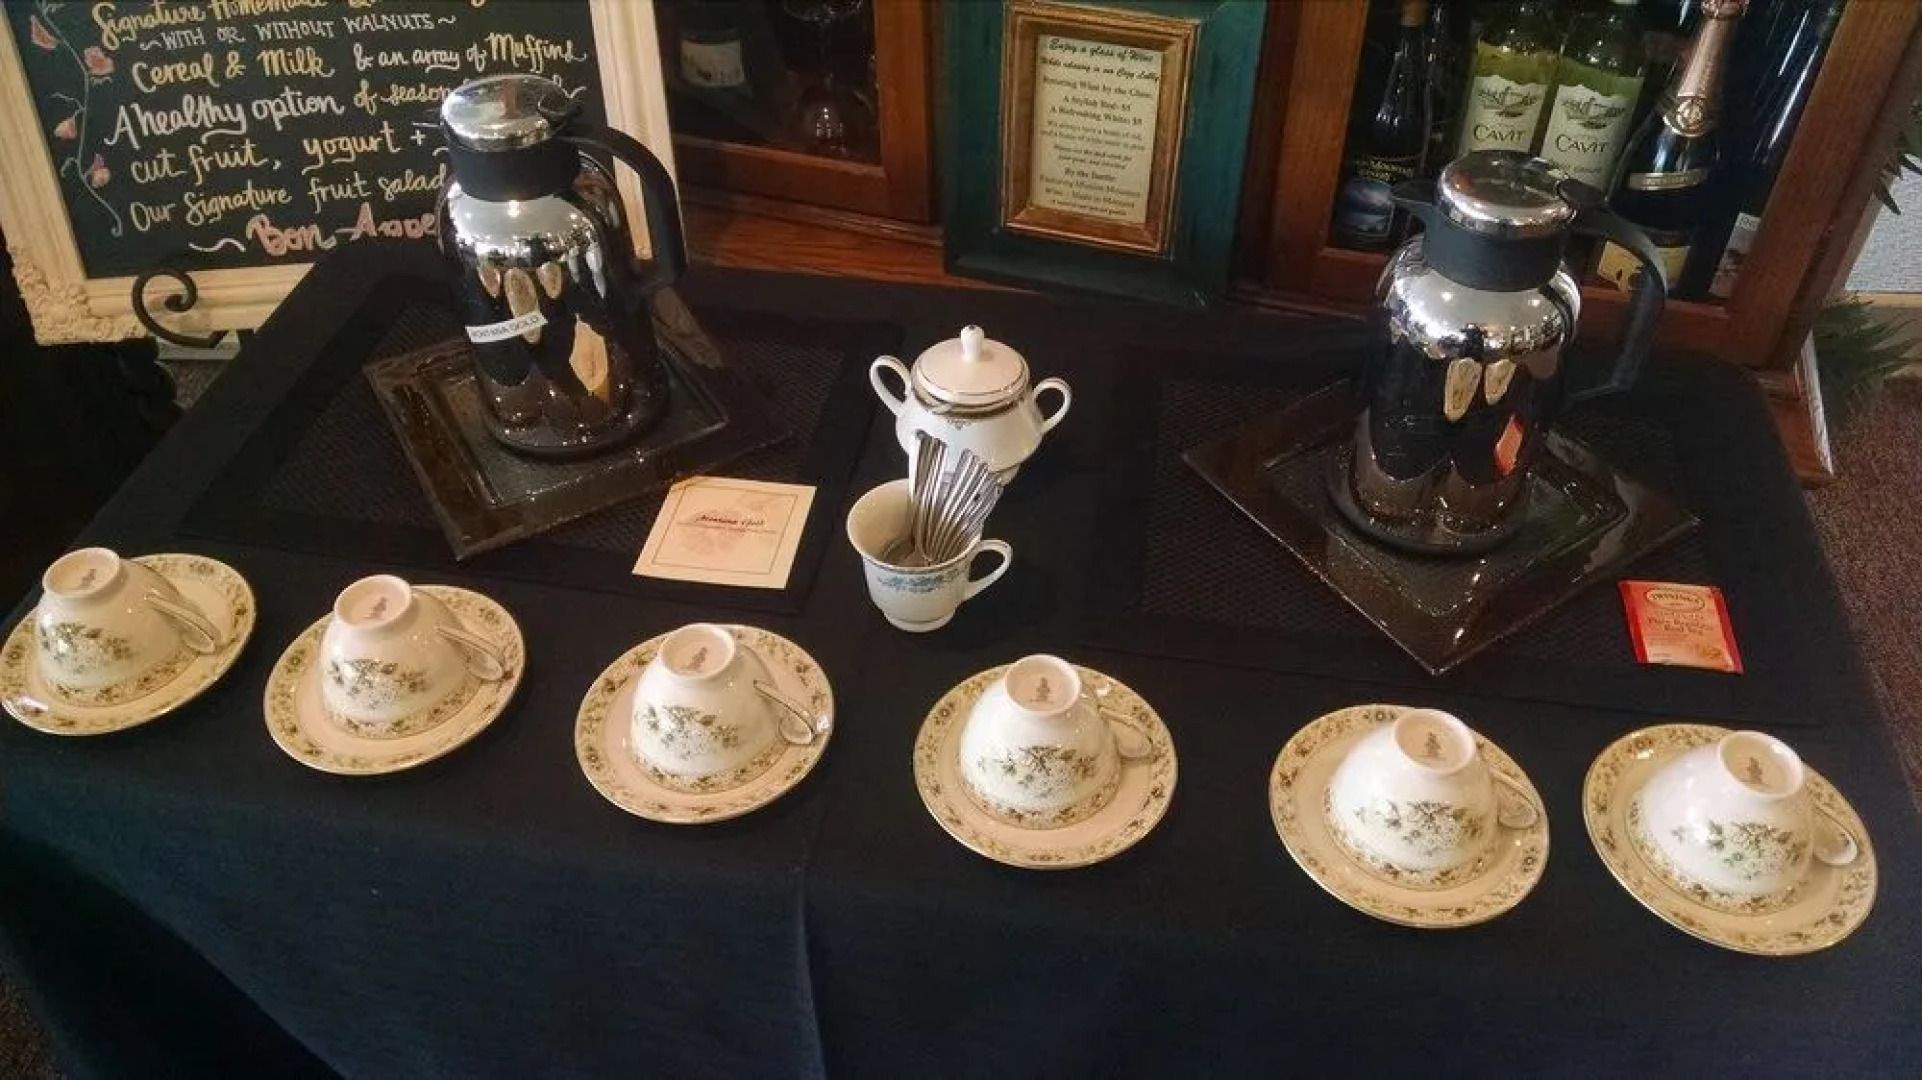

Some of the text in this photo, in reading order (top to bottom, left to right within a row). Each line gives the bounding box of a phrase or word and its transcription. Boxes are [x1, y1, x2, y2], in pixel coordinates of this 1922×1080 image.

[92, 2, 205, 49] Signature
[161, 14, 435, 49] WITH OR WITHOUT WALNUTS
[1049, 38, 1077, 54] Enjoy
[1090, 46, 1114, 58] glass
[132, 52, 220, 92] Cereal
[226, 51, 246, 79] &
[256, 46, 335, 77] Milk
[378, 52, 408, 66] an
[413, 50, 460, 74] array
[466, 43, 488, 72] of
[485, 32, 587, 74] Muffins
[130, 94, 247, 145] healthy
[252, 85, 345, 131] option
[353, 78, 378, 115] of
[130, 149, 187, 184] cut
[301, 120, 400, 175] yogurt
[130, 163, 446, 232] Our Signature fruit salad
[246, 213, 337, 256] Bon
